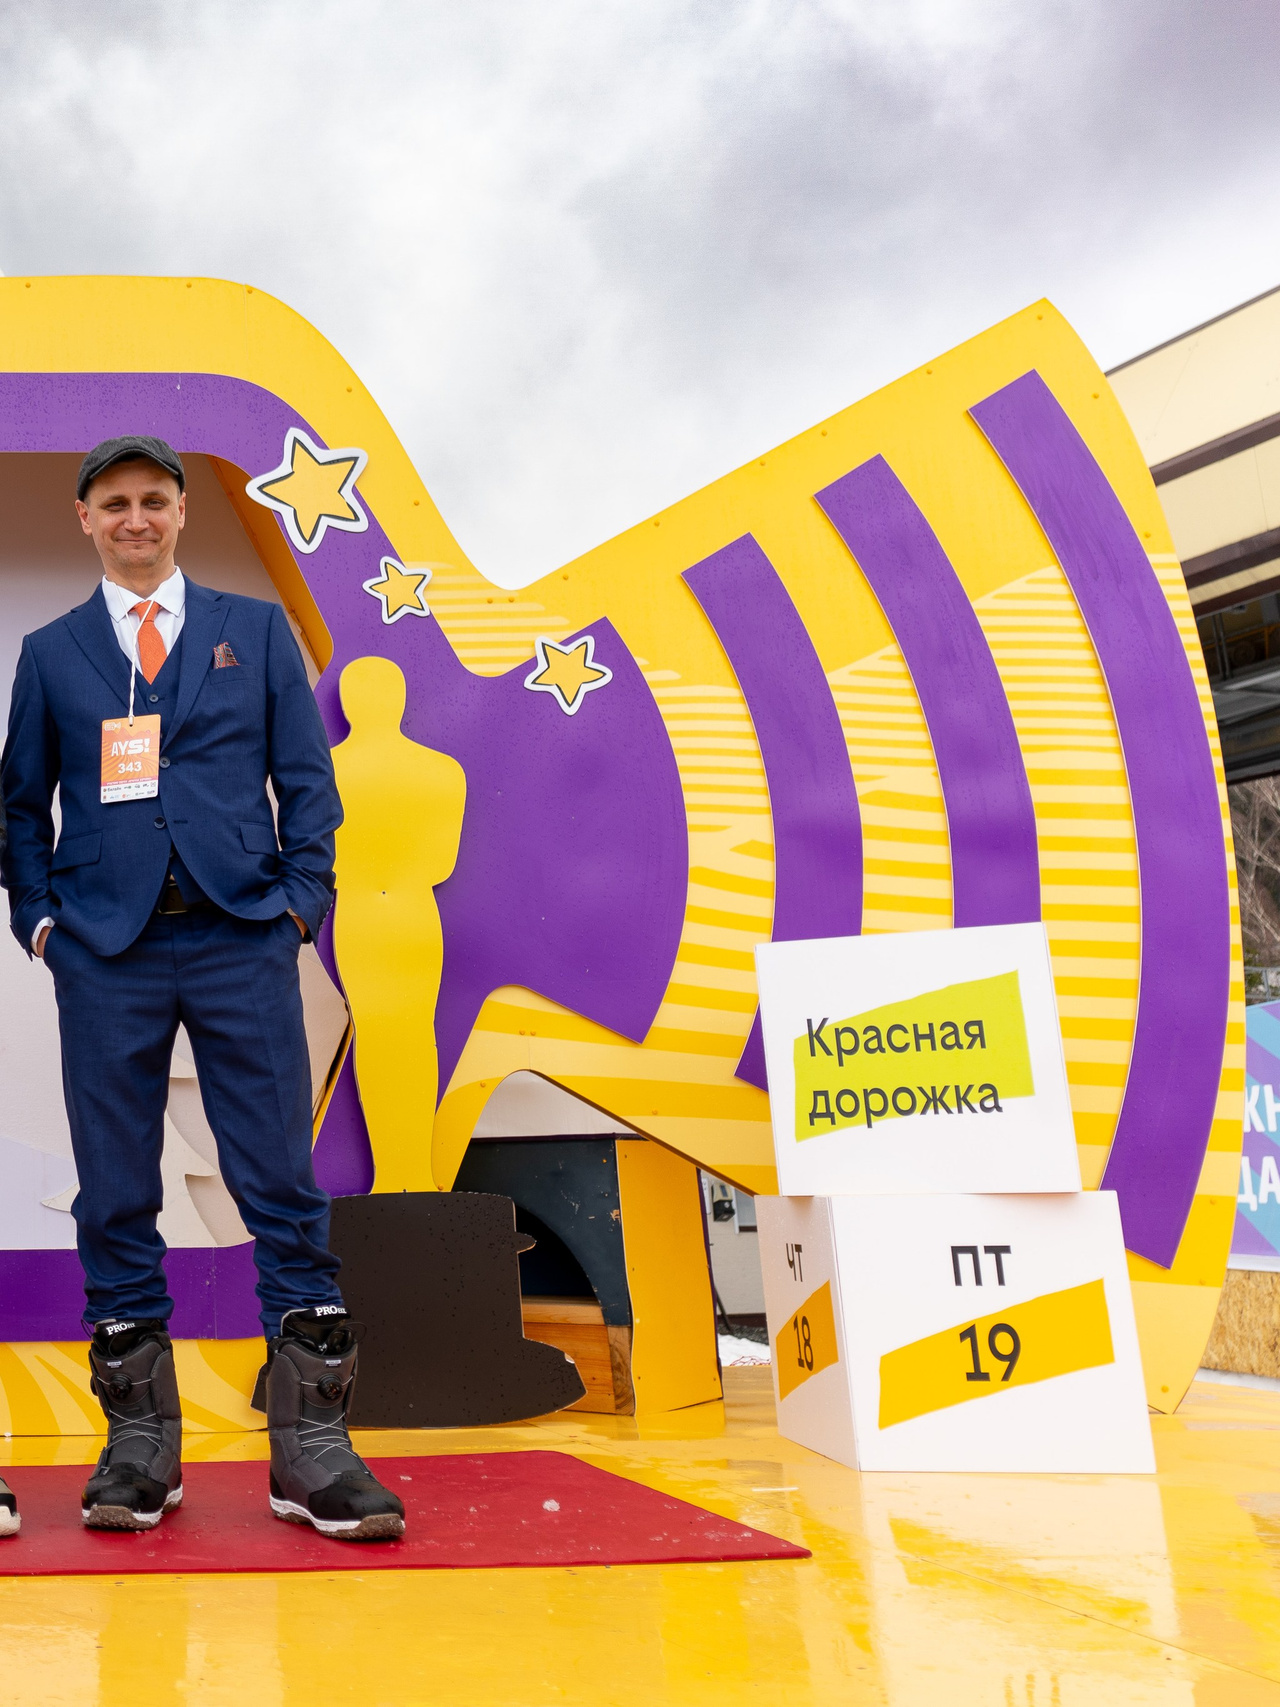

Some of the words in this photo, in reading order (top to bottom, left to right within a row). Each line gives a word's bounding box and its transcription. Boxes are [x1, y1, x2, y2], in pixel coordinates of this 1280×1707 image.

[111, 738, 150, 757] AYS!
[118, 762, 142, 774] 343
[805, 1017, 987, 1067] Красная
[808, 1081, 1003, 1129] дорожка
[786, 1242, 804, 1283] ЧТ
[950, 1245, 1012, 1287] ПТ
[792, 1314, 815, 1372] 18
[959, 1322, 1022, 1382] 19
